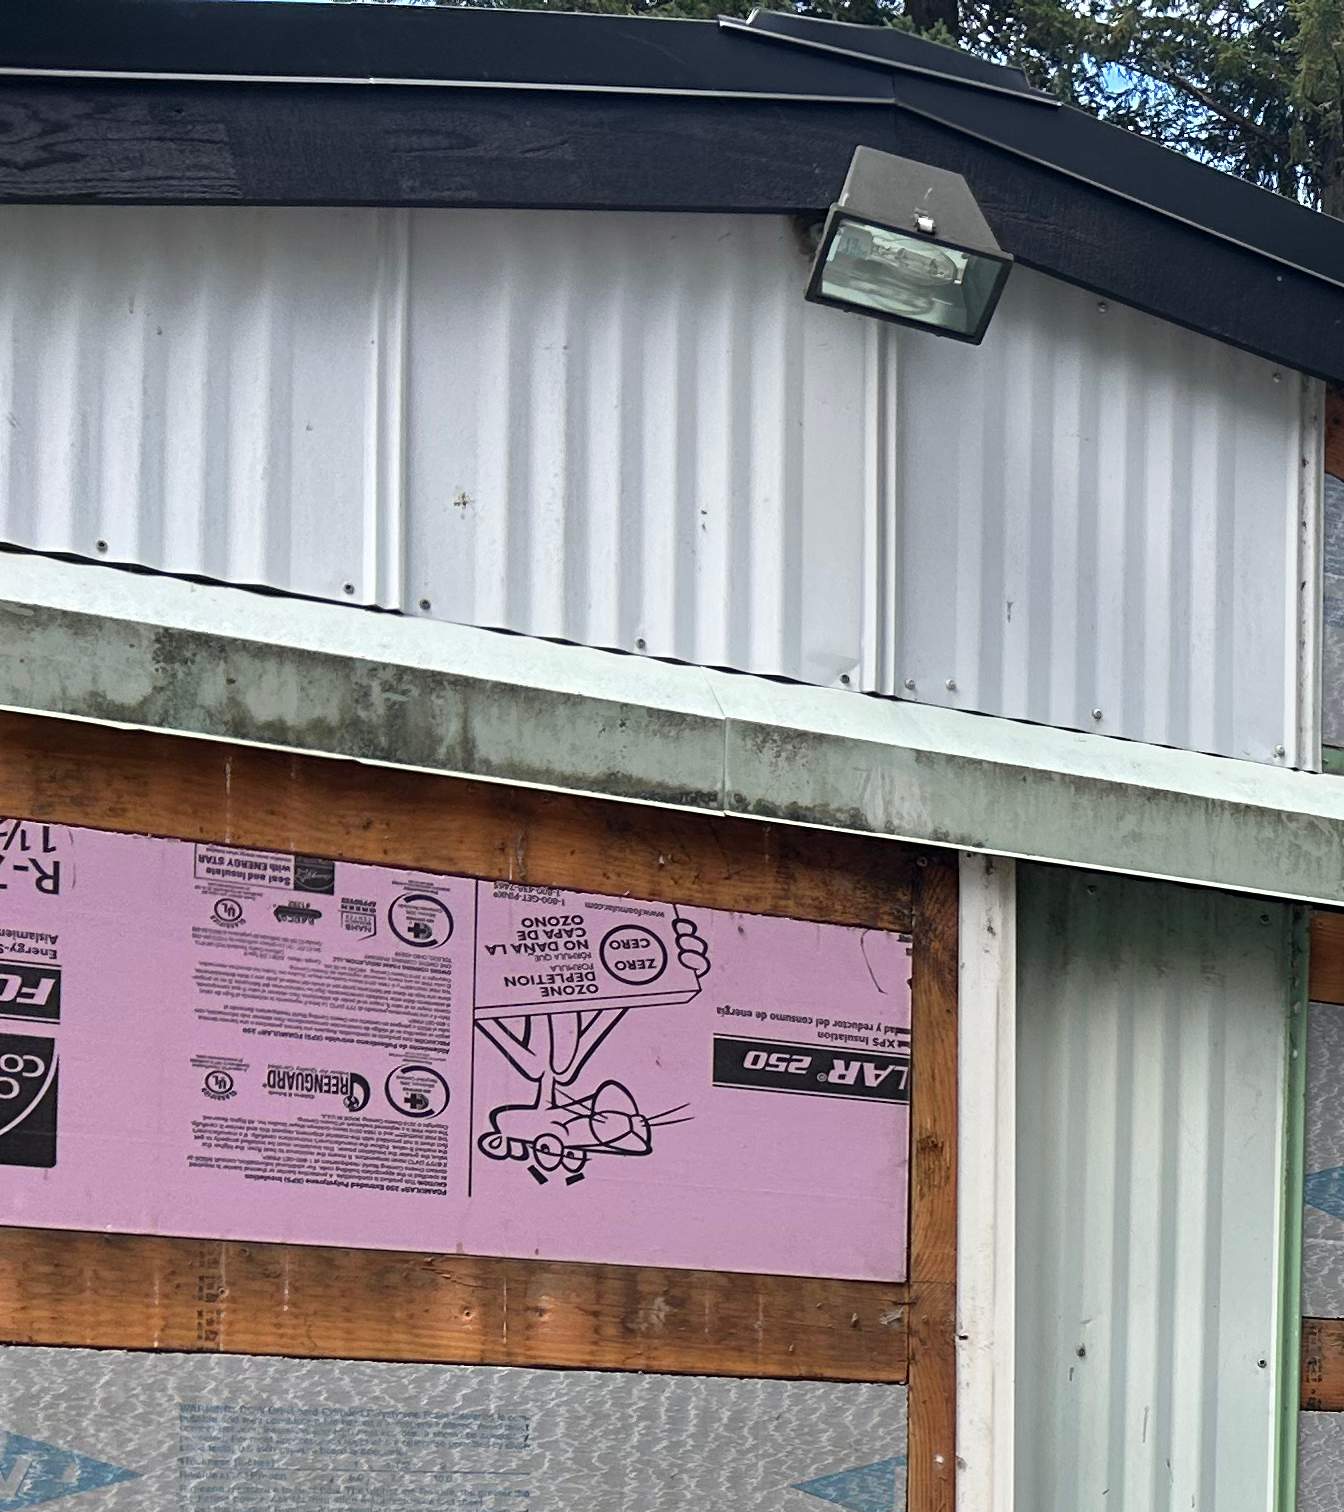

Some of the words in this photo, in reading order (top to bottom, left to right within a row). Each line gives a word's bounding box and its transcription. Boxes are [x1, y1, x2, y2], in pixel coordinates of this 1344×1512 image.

[197, 854, 224, 866] STAR
[227, 858, 268, 871] ENERGY
[205, 867, 246, 880] Insulate
[268, 864, 290, 873] with
[248, 872, 266, 882] and
[268, 874, 291, 886] Seal
[221, 902, 236, 918] UL
[584, 902, 665, 918] www.foamular.com
[521, 915, 584, 929] OZONO
[516, 930, 539, 941] DE
[542, 927, 587, 940] CAPA
[484, 944, 507, 956] LA
[510, 941, 559, 956] DAÑA
[563, 940, 590, 951] NO
[609, 938, 650, 950] CERO
[550, 963, 594, 972] FORMULA
[614, 958, 657, 971] ZERO
[504, 971, 596, 987] DEPLETION
[540, 984, 599, 997] OZONE
[716, 1005, 753, 1019] energía
[755, 1011, 768, 1022] de
[770, 1011, 813, 1025] consumo
[815, 1018, 831, 1029] del
[831, 1020, 874, 1033] reductor
[816, 1031, 869, 1047] Insulation
[872, 1037, 896, 1049] XPS
[742, 1050, 813, 1074] 250
[212, 1076, 227, 1090] UL
